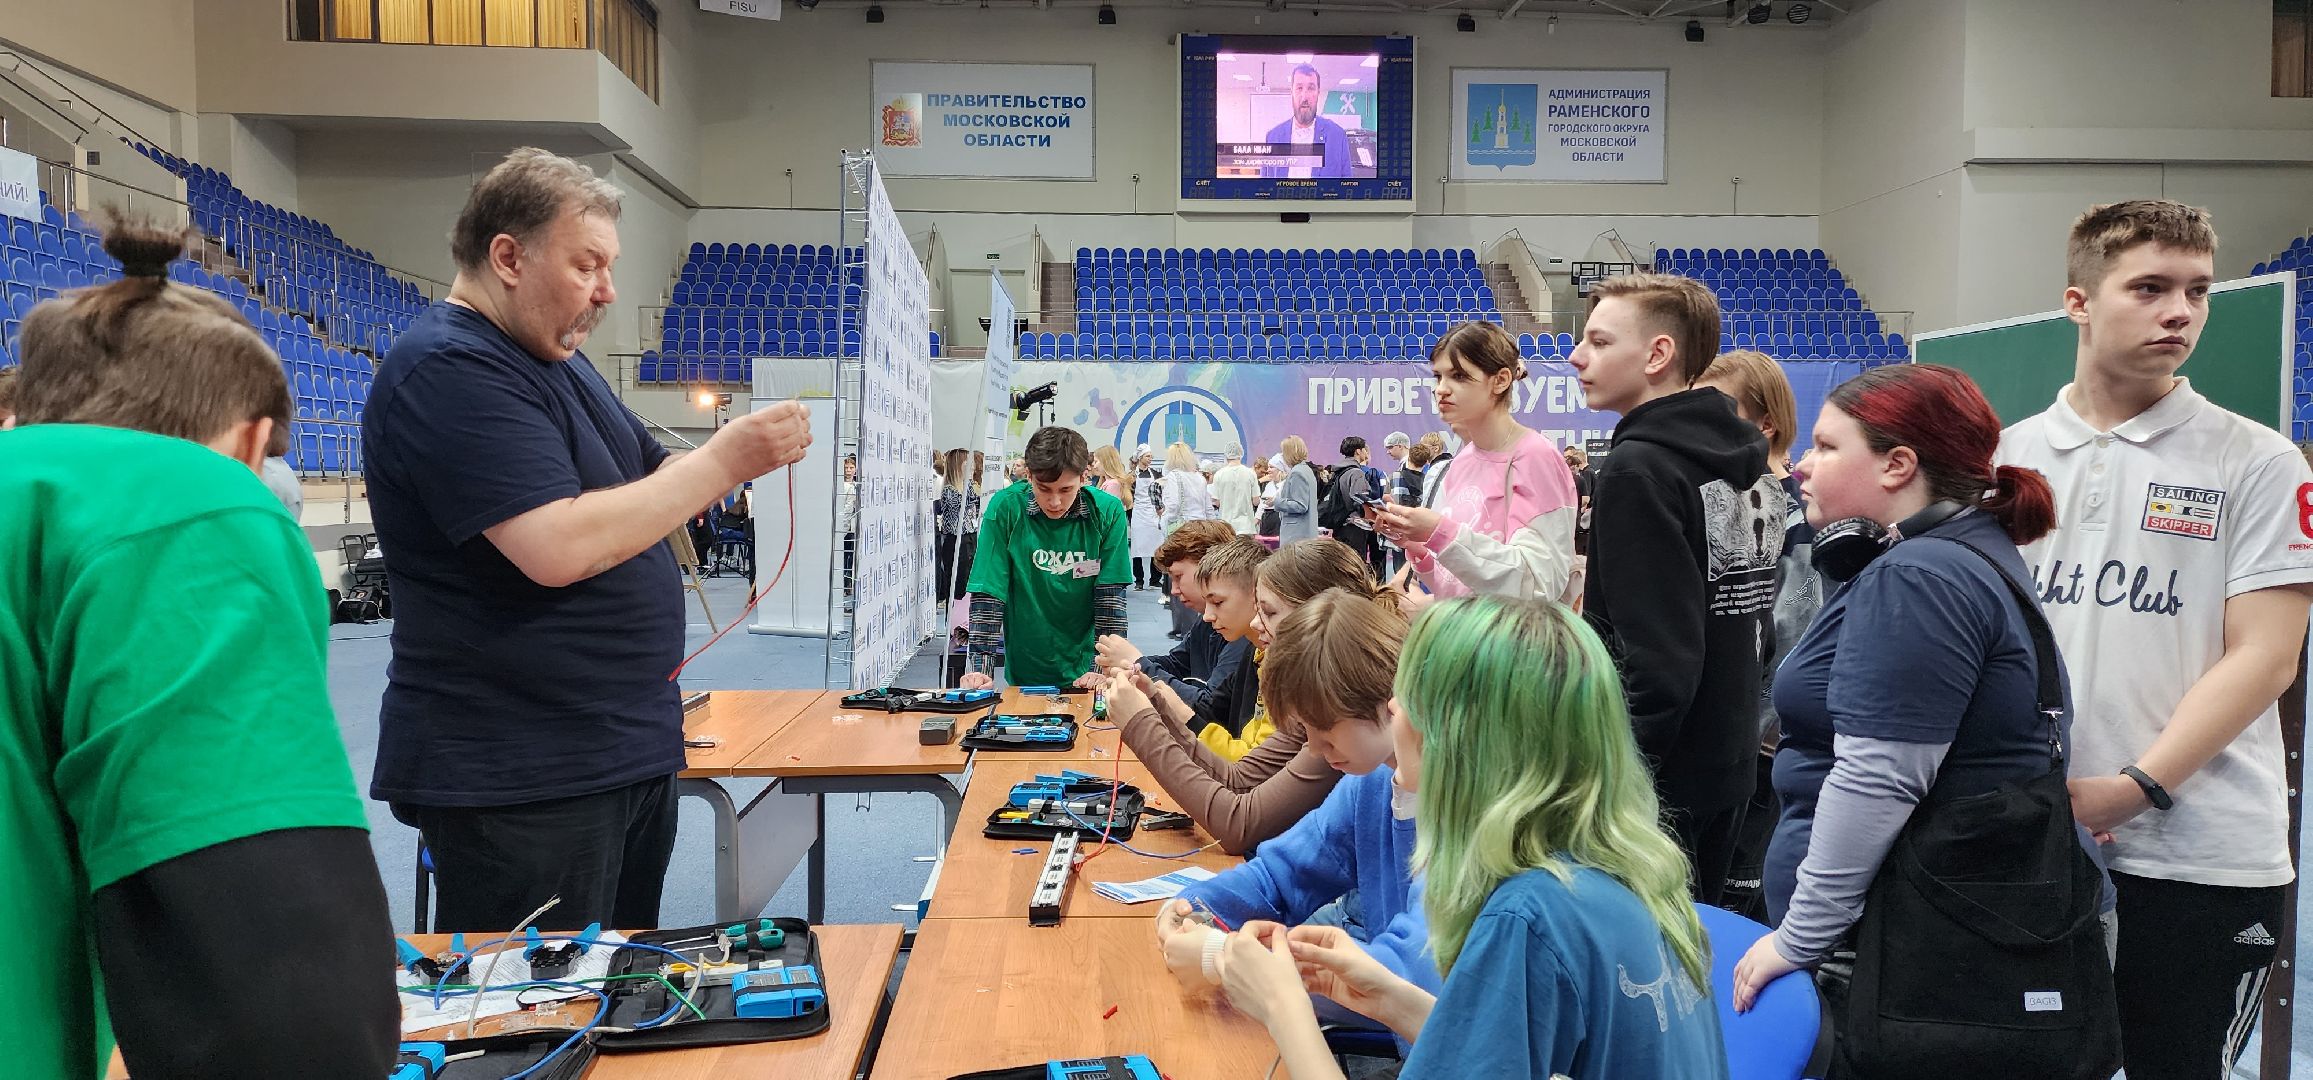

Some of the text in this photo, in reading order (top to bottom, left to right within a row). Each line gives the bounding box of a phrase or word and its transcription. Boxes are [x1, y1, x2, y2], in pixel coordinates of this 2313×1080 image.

[729, 1, 757, 13] FISU
[1548, 89, 1651, 99] АДМИНИСТРАЦИЯ
[927, 94, 1086, 109] ПРАВИТЕЛЬСТВО
[1548, 105, 1650, 118] РАМЕНСКОГО
[943, 113, 1070, 128] МОСКОВСКОЙ
[1548, 124, 1650, 133] ГОРОДСКОГО ОКРУГА
[963, 134, 1051, 147] ОБЛАСТИ
[1560, 136, 1637, 147] МОСКОВСКОЙ
[1572, 152, 1624, 162] ОБЛАСТИ
[2155, 486, 2216, 505] SAILING
[2150, 517, 2210, 536] SKIPPER
[2096, 559, 2184, 616] Club
[2233, 935, 2275, 946] adidas
